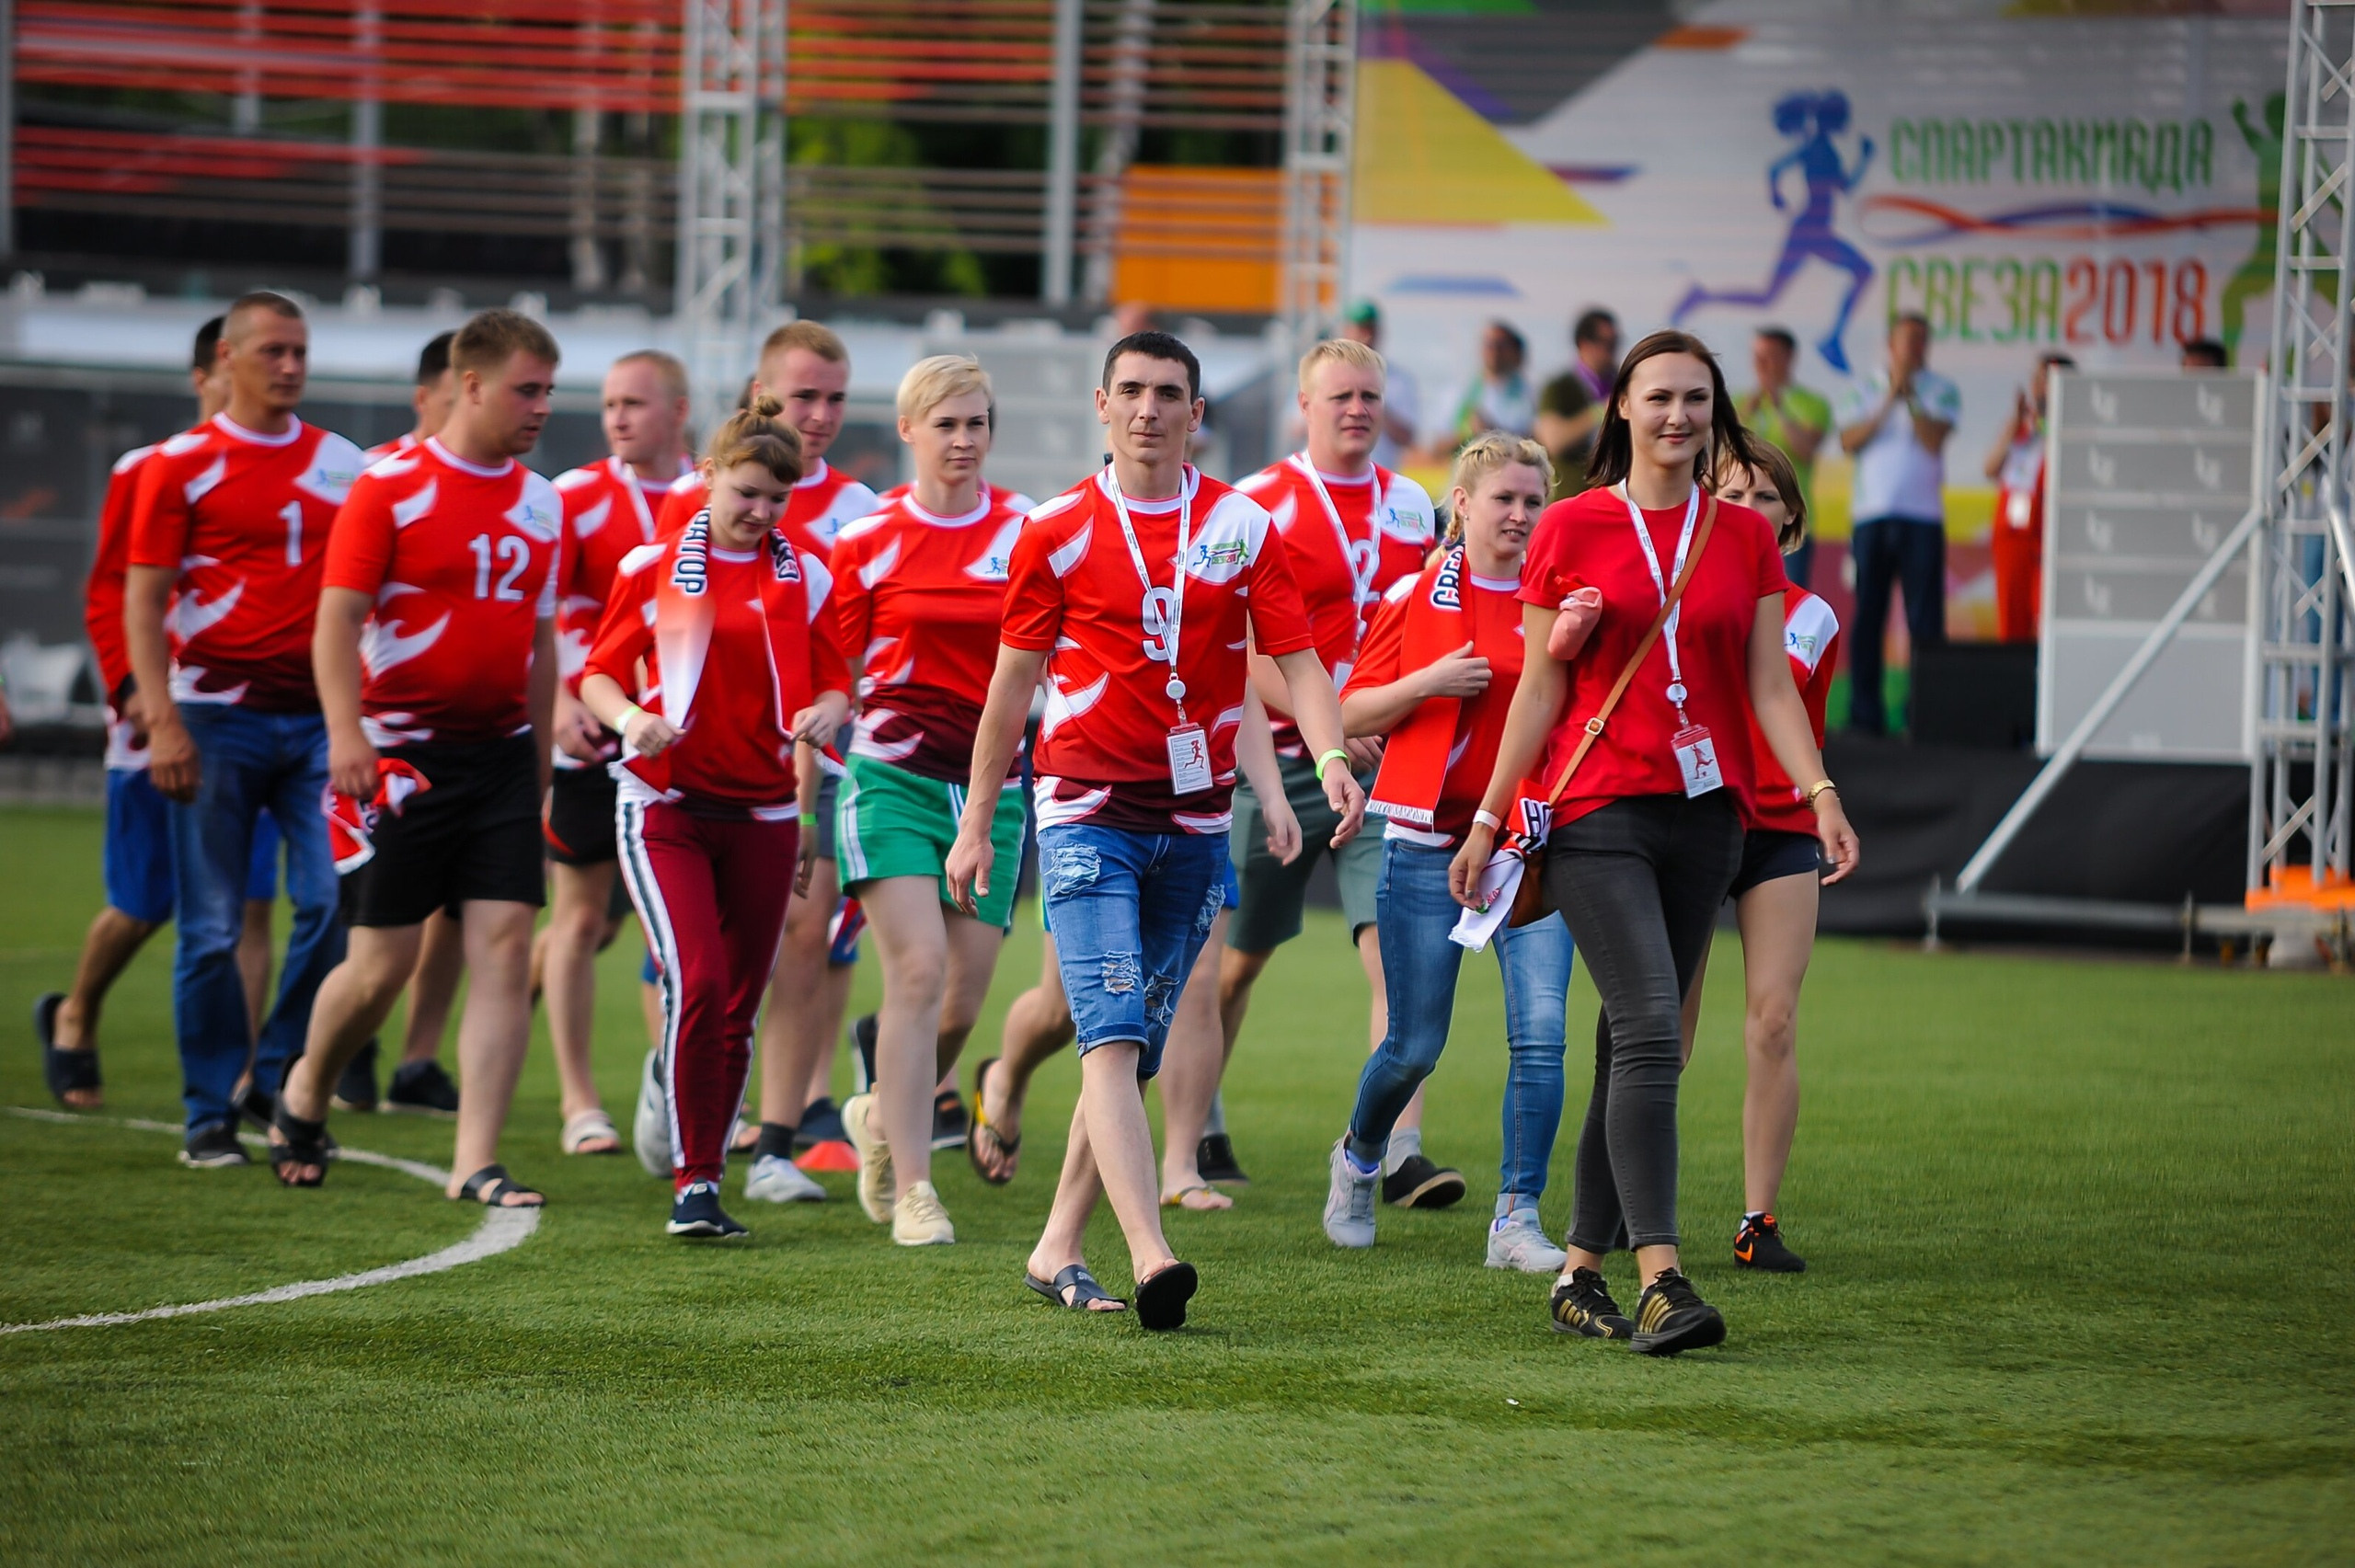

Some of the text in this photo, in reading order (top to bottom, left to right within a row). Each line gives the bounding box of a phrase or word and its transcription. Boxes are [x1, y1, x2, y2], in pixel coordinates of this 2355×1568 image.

[1890, 117, 2213, 196] СПАРТАКИАДА
[278, 499, 304, 567] 1
[467, 532, 532, 601] 12
[1142, 585, 1178, 661] 9
